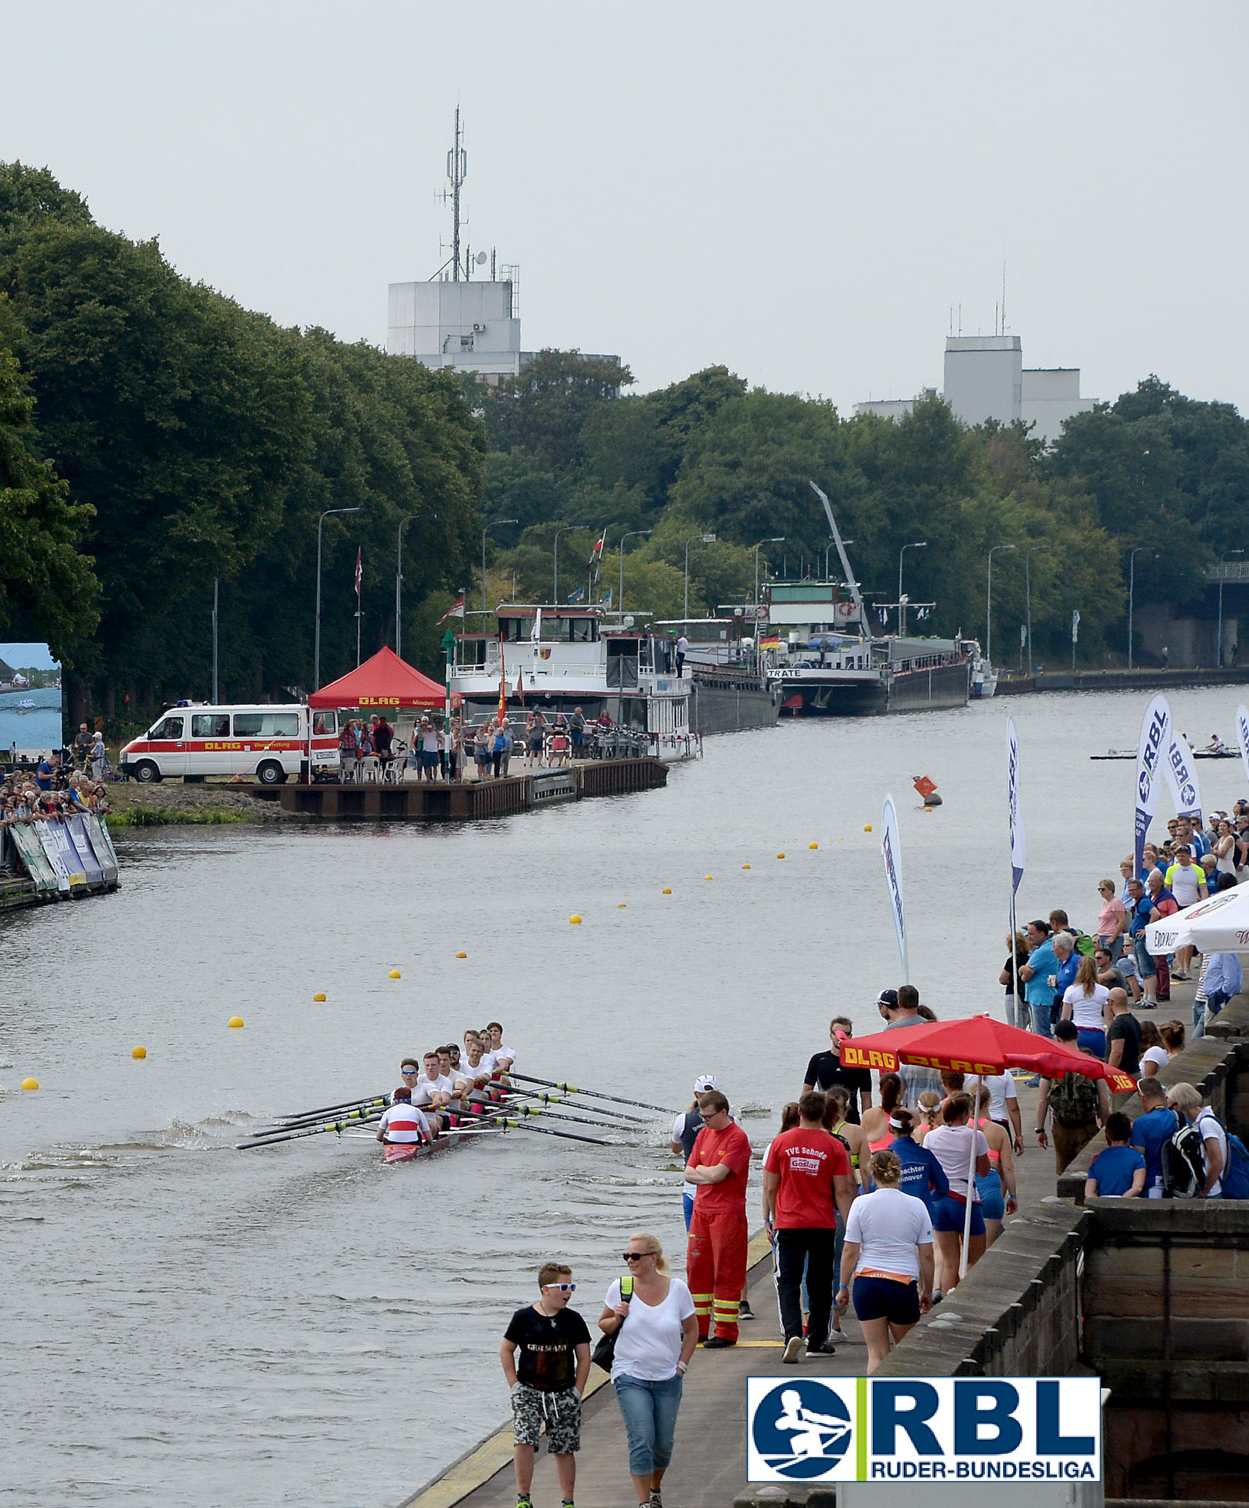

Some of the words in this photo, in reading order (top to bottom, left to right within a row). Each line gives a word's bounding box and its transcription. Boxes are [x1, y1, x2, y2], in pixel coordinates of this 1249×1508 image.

[358, 697, 400, 705] DLRG
[204, 742, 241, 750] DLRG
[1143, 710, 1167, 772] RBL
[845, 1048, 896, 1069] DLRG
[907, 1055, 998, 1075] DLRG
[784, 1146, 800, 1157] TVE
[801, 1146, 828, 1160] Sehnde
[791, 1160, 818, 1169] Goslar
[527, 1343, 567, 1352] GERMANY
